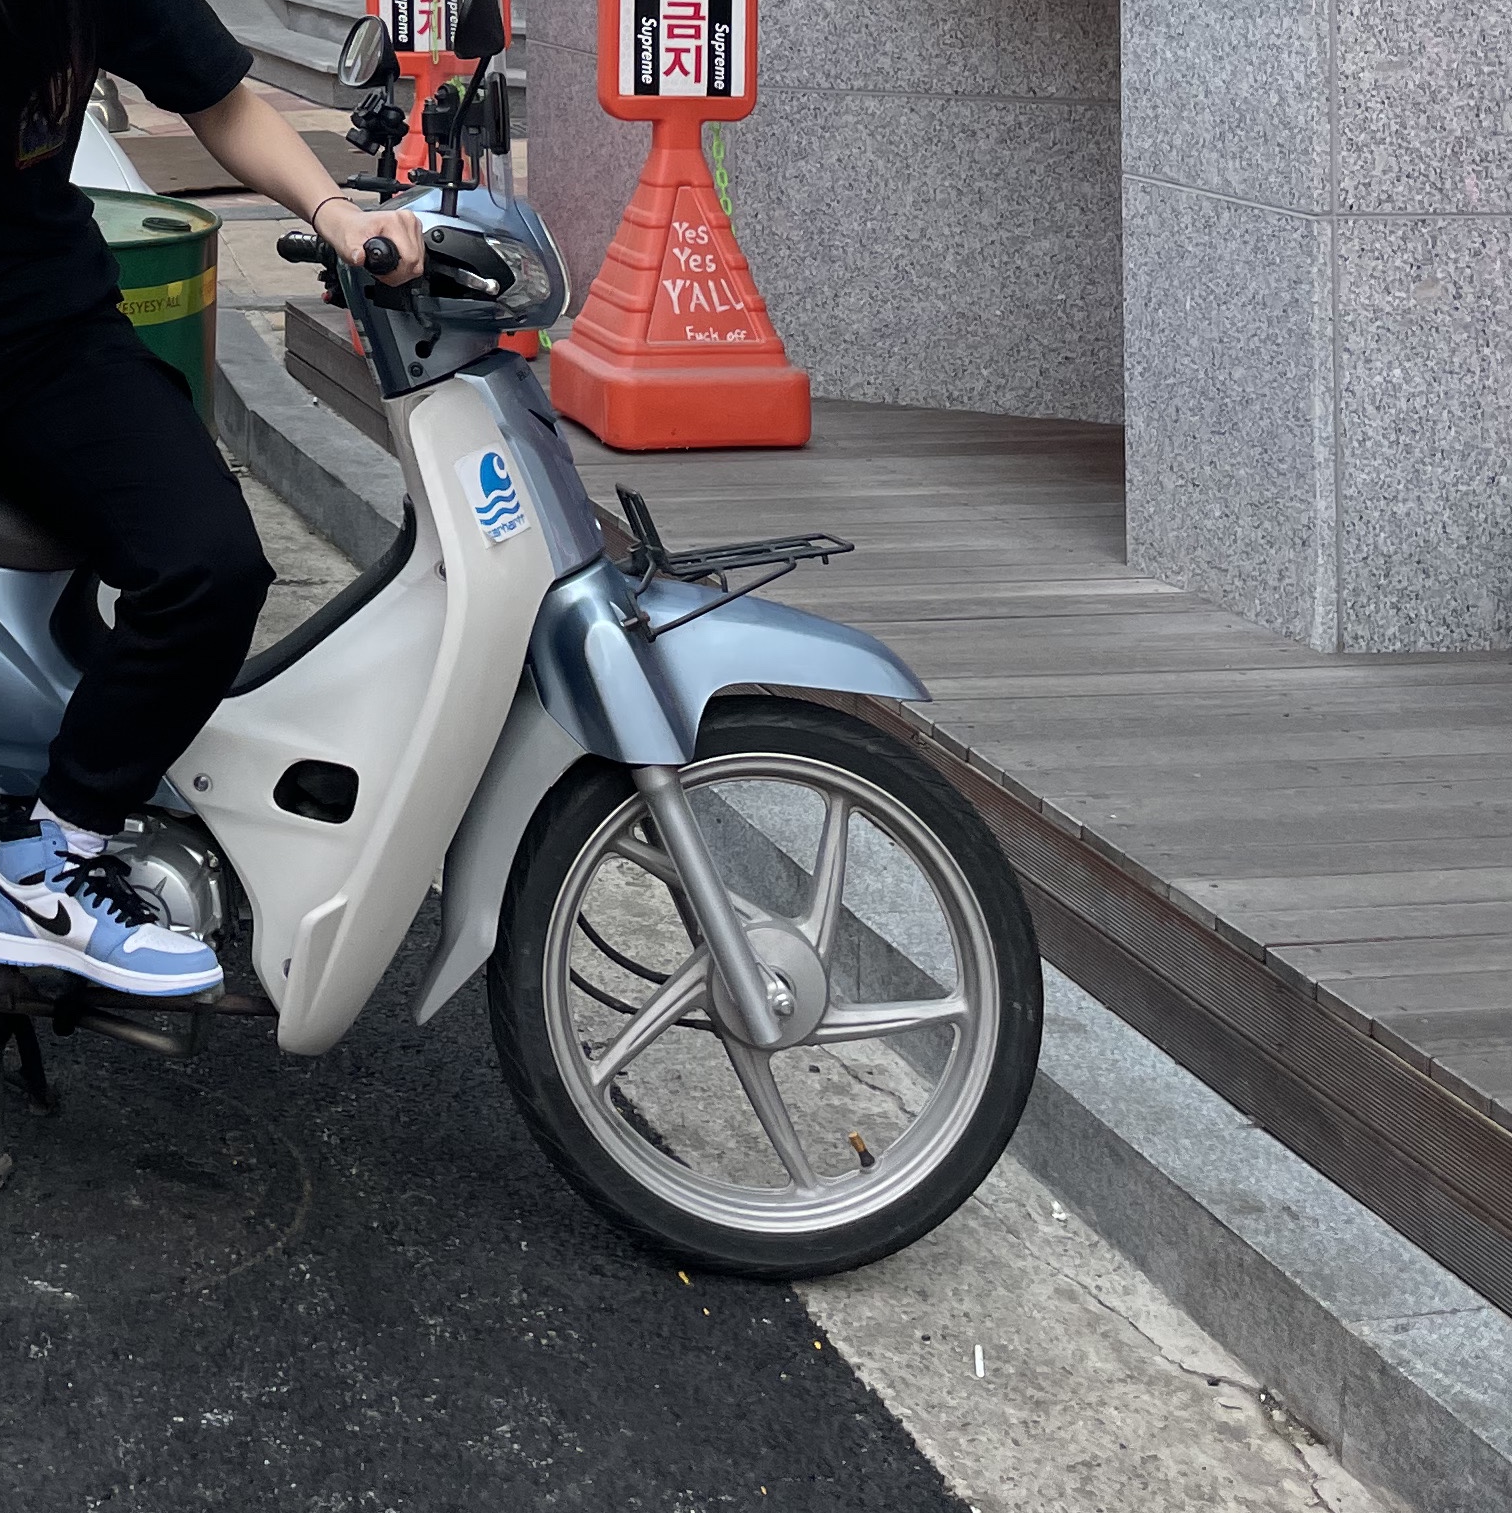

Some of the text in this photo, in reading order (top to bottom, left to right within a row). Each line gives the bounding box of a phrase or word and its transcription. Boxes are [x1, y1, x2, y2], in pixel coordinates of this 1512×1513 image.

[637, 16, 658, 85] Supreme
[710, 22, 730, 91] Supreme
[672, 246, 717, 273] Yes
[662, 278, 745, 316] Y'ALL
[685, 325, 720, 342] Fuck
